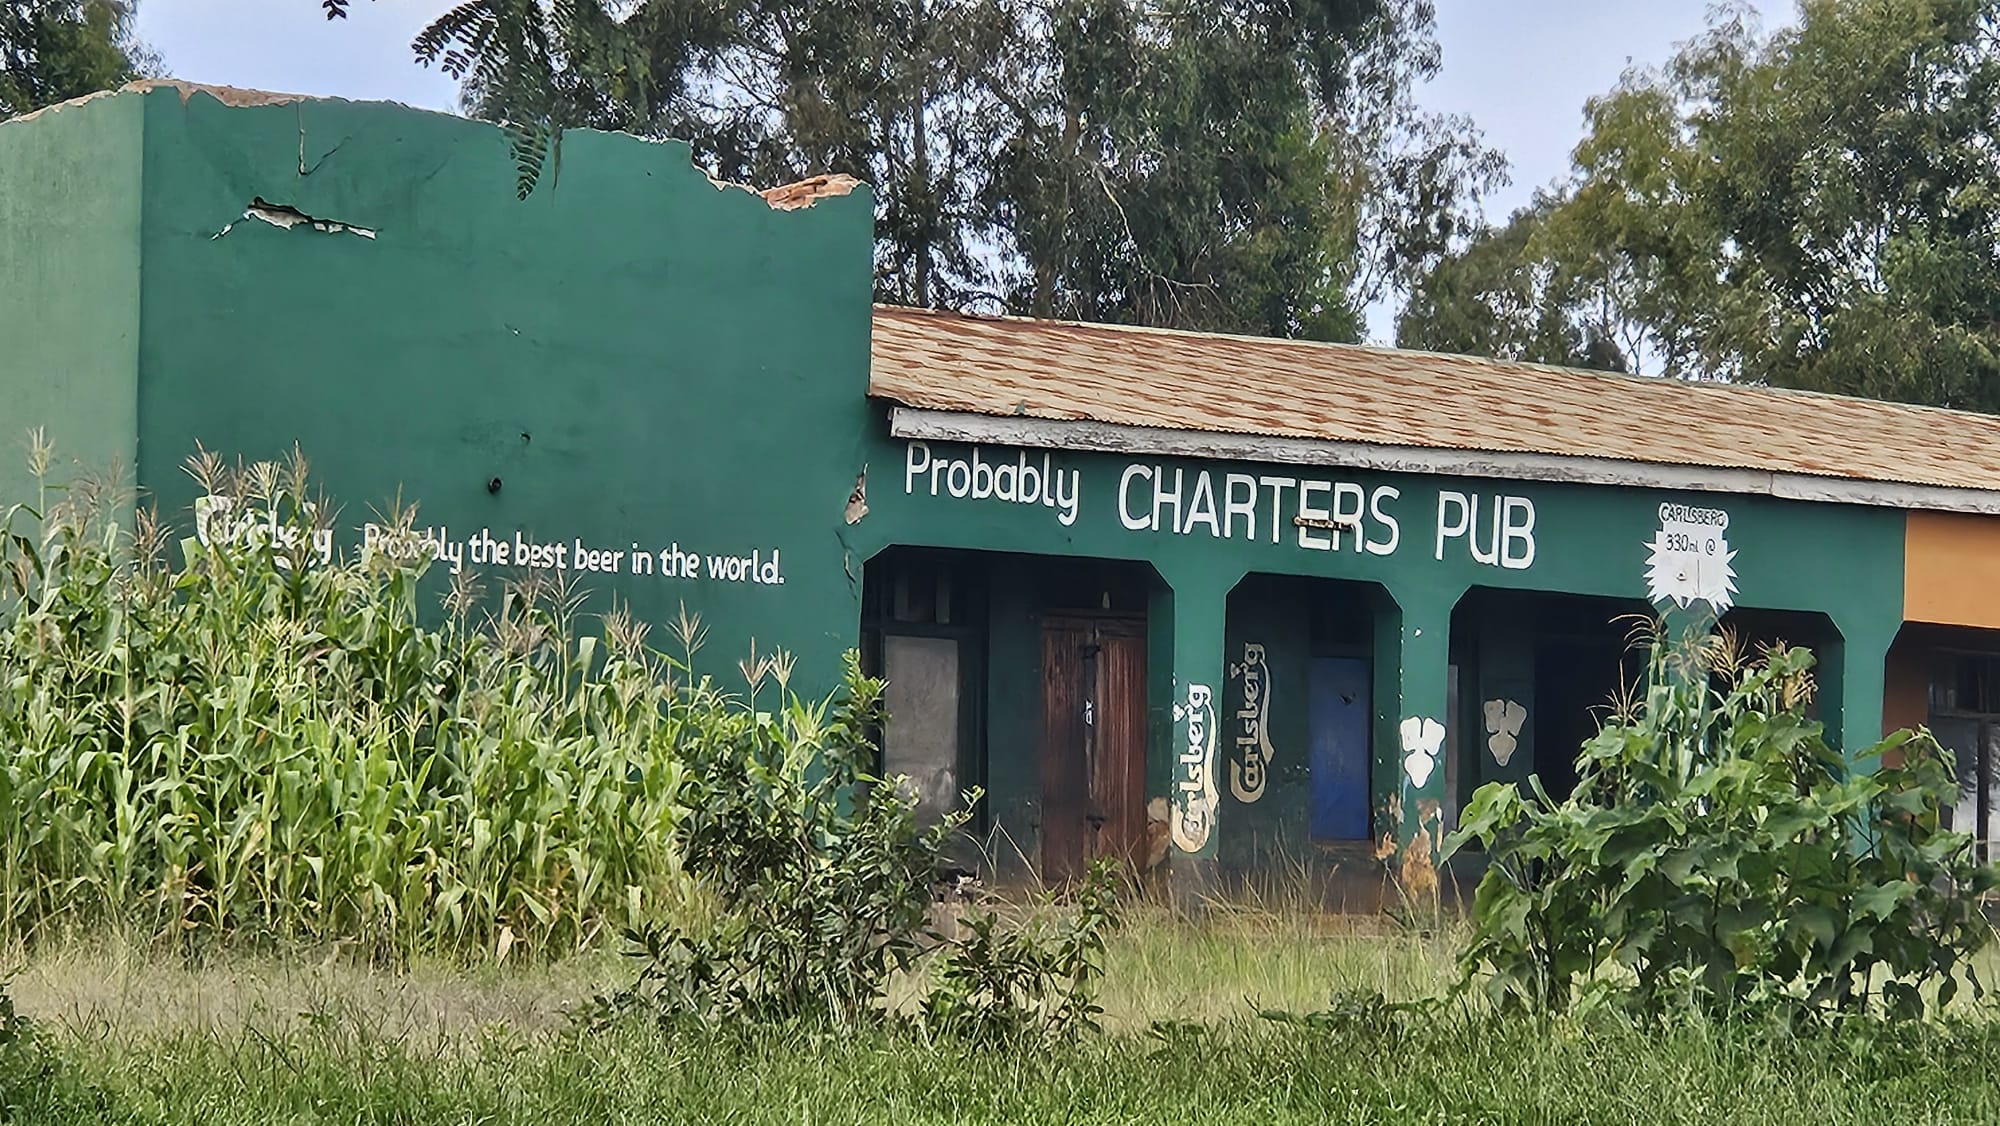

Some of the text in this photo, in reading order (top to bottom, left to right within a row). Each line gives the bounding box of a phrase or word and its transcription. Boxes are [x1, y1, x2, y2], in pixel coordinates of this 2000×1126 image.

[905, 441, 1535, 569] Probably CHARTERS PUB
[1659, 504, 1726, 528] CARLSBERG
[468, 528, 510, 565] the
[514, 531, 567, 569] best
[574, 537, 624, 573] beer
[631, 542, 652, 575] in
[659, 542, 700, 578] the
[706, 549, 785, 585] world.
[1230, 642, 1275, 803] Carlsberg
